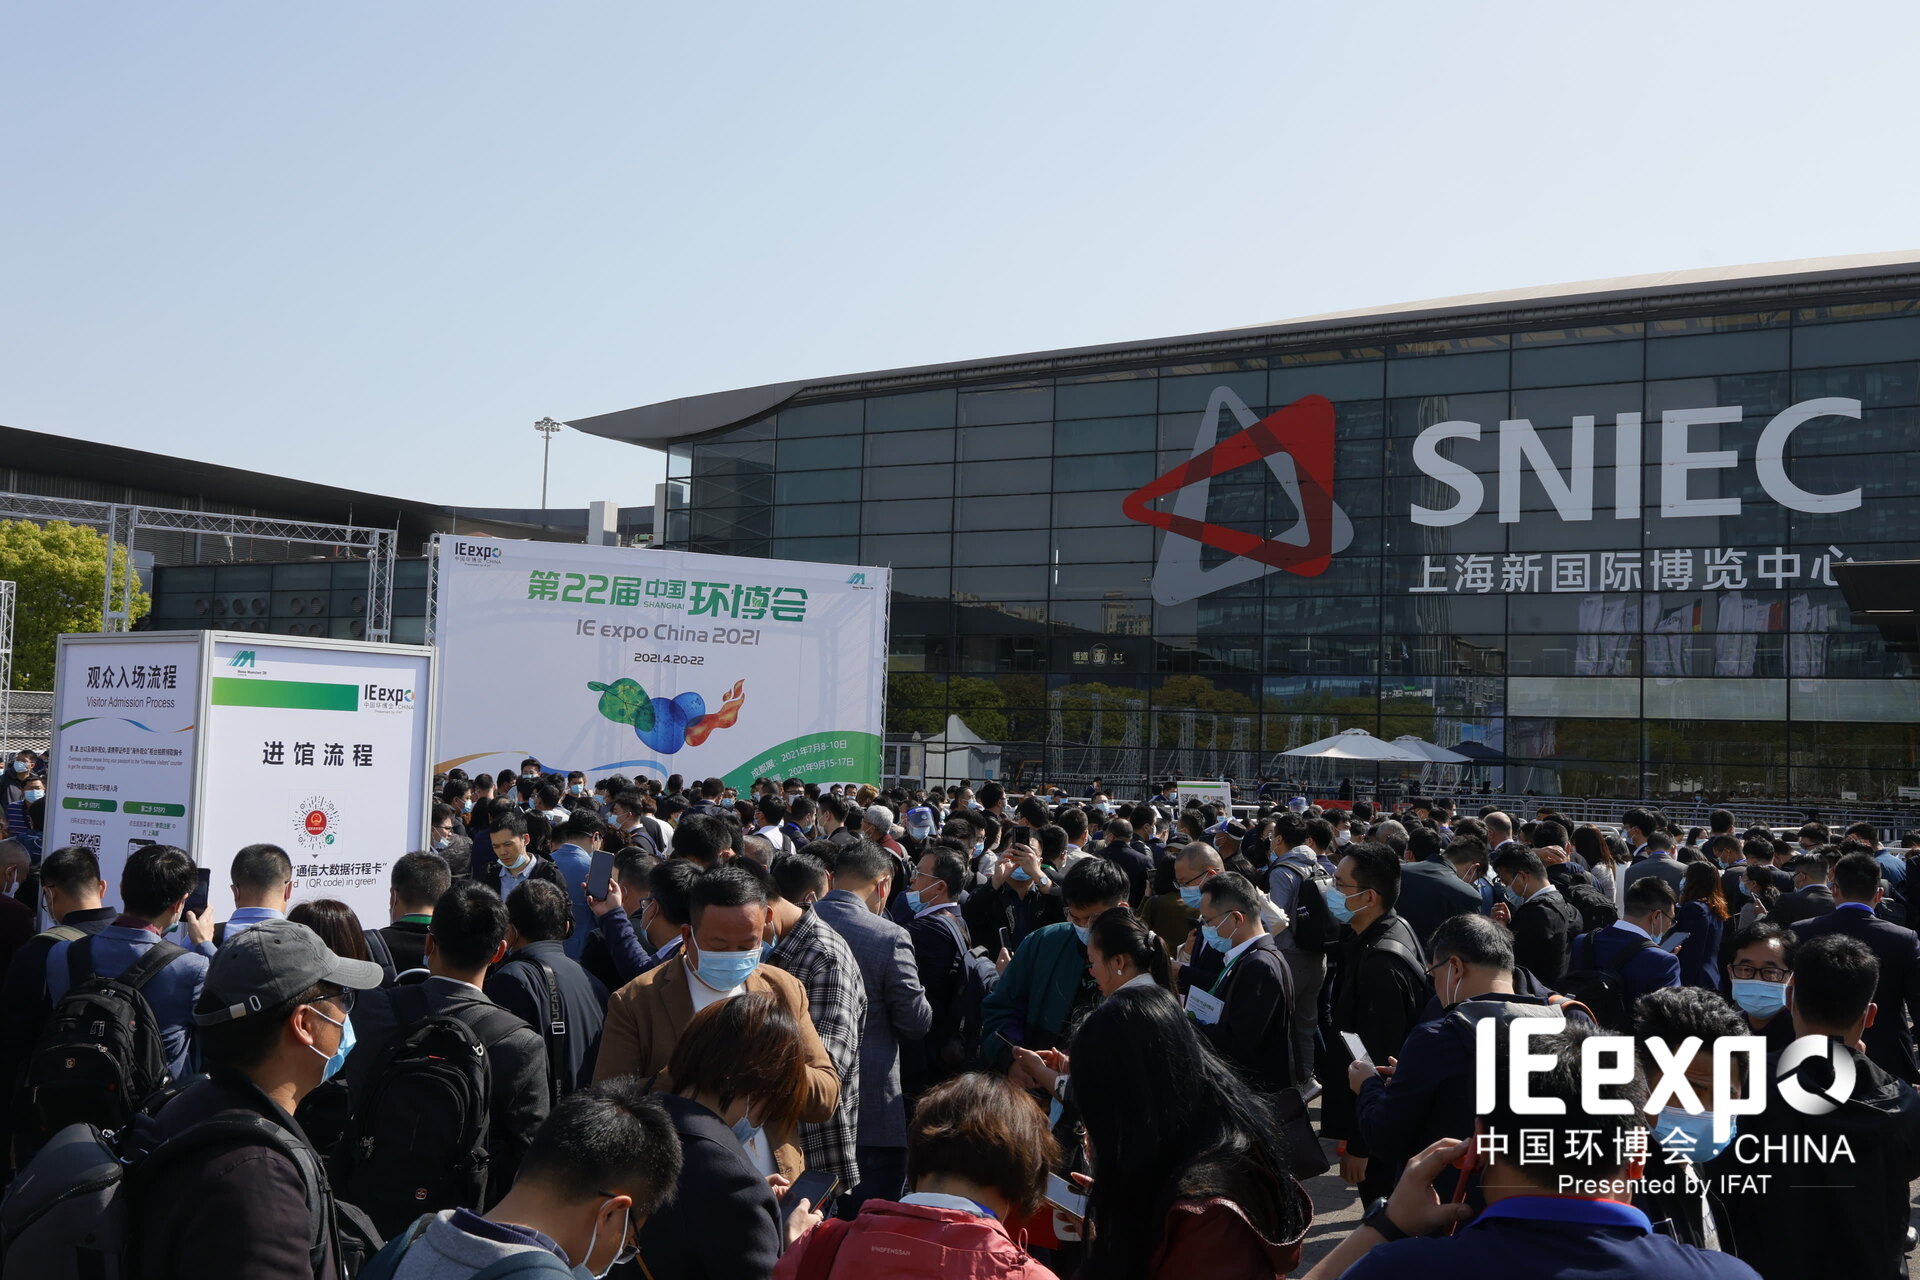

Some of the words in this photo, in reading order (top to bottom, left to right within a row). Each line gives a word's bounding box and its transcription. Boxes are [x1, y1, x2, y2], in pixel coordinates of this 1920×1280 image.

[1410, 397, 1863, 527] SNIEC
[455, 542, 502, 560] IEexpo
[1409, 545, 1854, 593] 上海新国际博览中心
[643, 600, 685, 610] SHANGHAI
[600, 624, 648, 642] expo
[654, 624, 708, 643] China
[712, 627, 760, 646] 2021
[634, 652, 704, 665] 2021.4.20-22
[87, 665, 177, 689] 观众入场流程
[87, 696, 107, 707] Visitor
[108, 696, 144, 708] Admission
[146, 697, 175, 708] Process
[364, 684, 415, 706] IEexpo
[305, 878, 321, 889] (QR
[323, 877, 345, 888] code)
[346, 877, 353, 886] in
[354, 877, 377, 888] green
